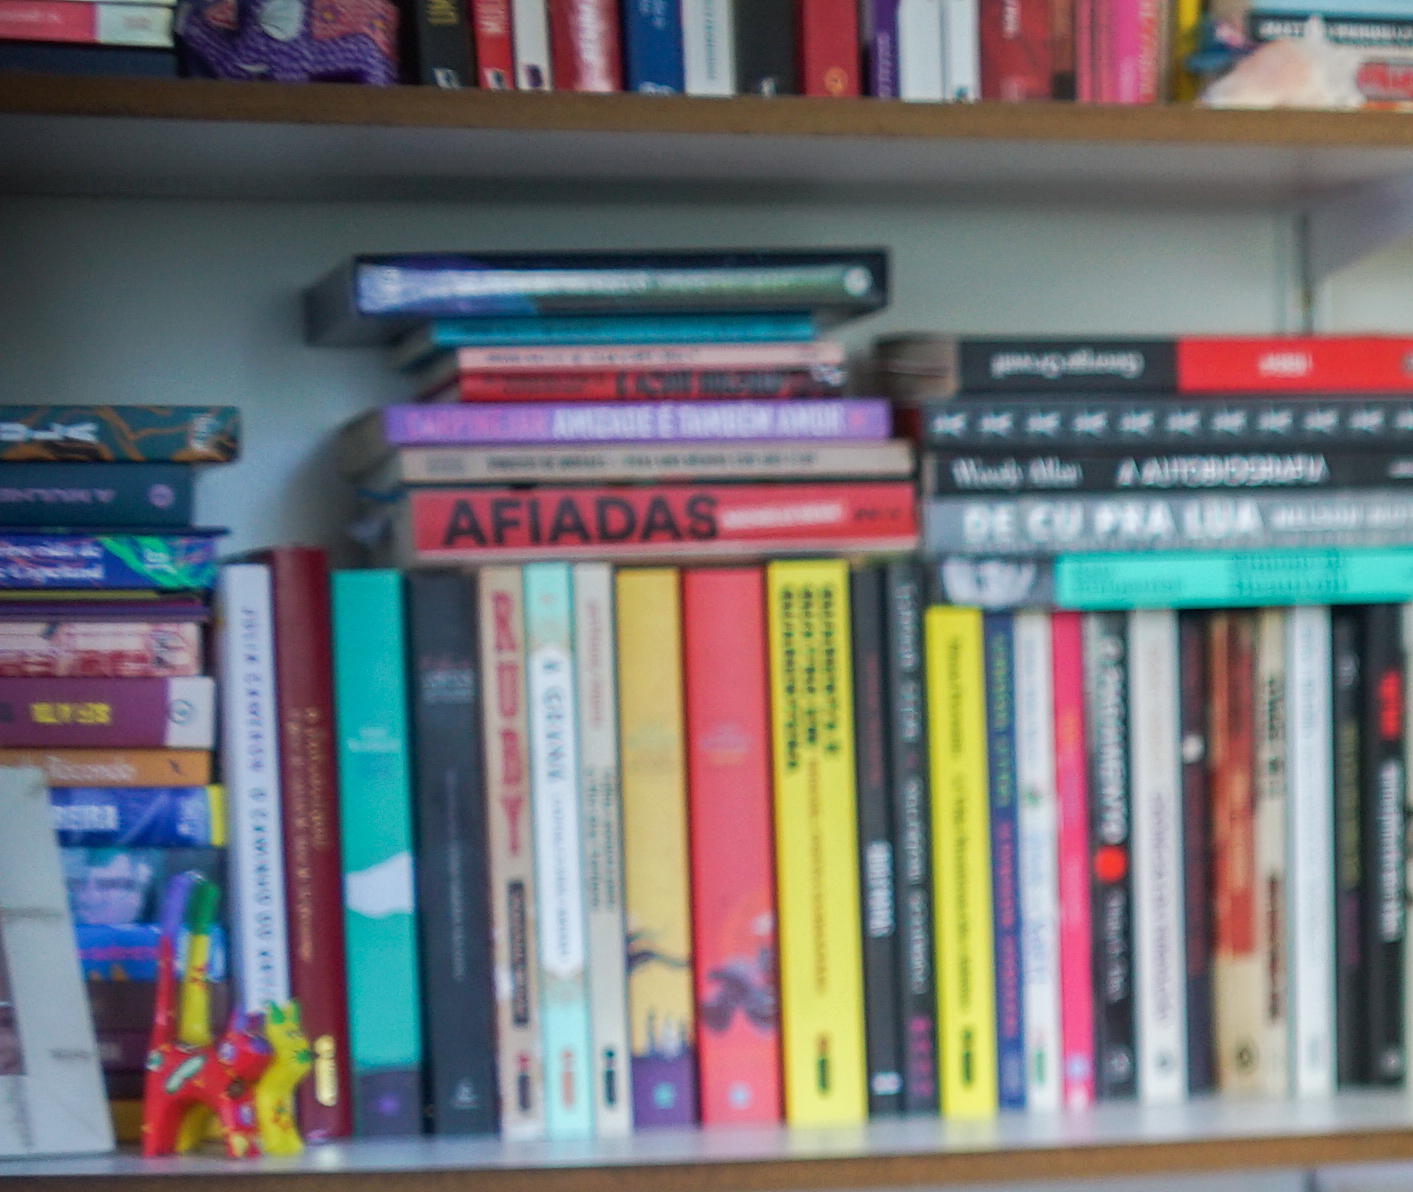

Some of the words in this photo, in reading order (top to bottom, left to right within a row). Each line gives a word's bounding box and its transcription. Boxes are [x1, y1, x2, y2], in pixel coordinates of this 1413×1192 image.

[552, 405, 654, 439] AMIZADE
[678, 402, 773, 437] TAMBÉM
[778, 404, 845, 437] AMOR
[950, 456, 1024, 490] Woody
[1027, 454, 1083, 488] Allen
[1138, 453, 1331, 487] AUTOBIOGRAFIA
[442, 494, 720, 548] AFIADAS
[961, 503, 1018, 542] DE
[1026, 501, 1086, 540] CU
[1094, 500, 1176, 539] PRA
[1183, 497, 1264, 537] LUA
